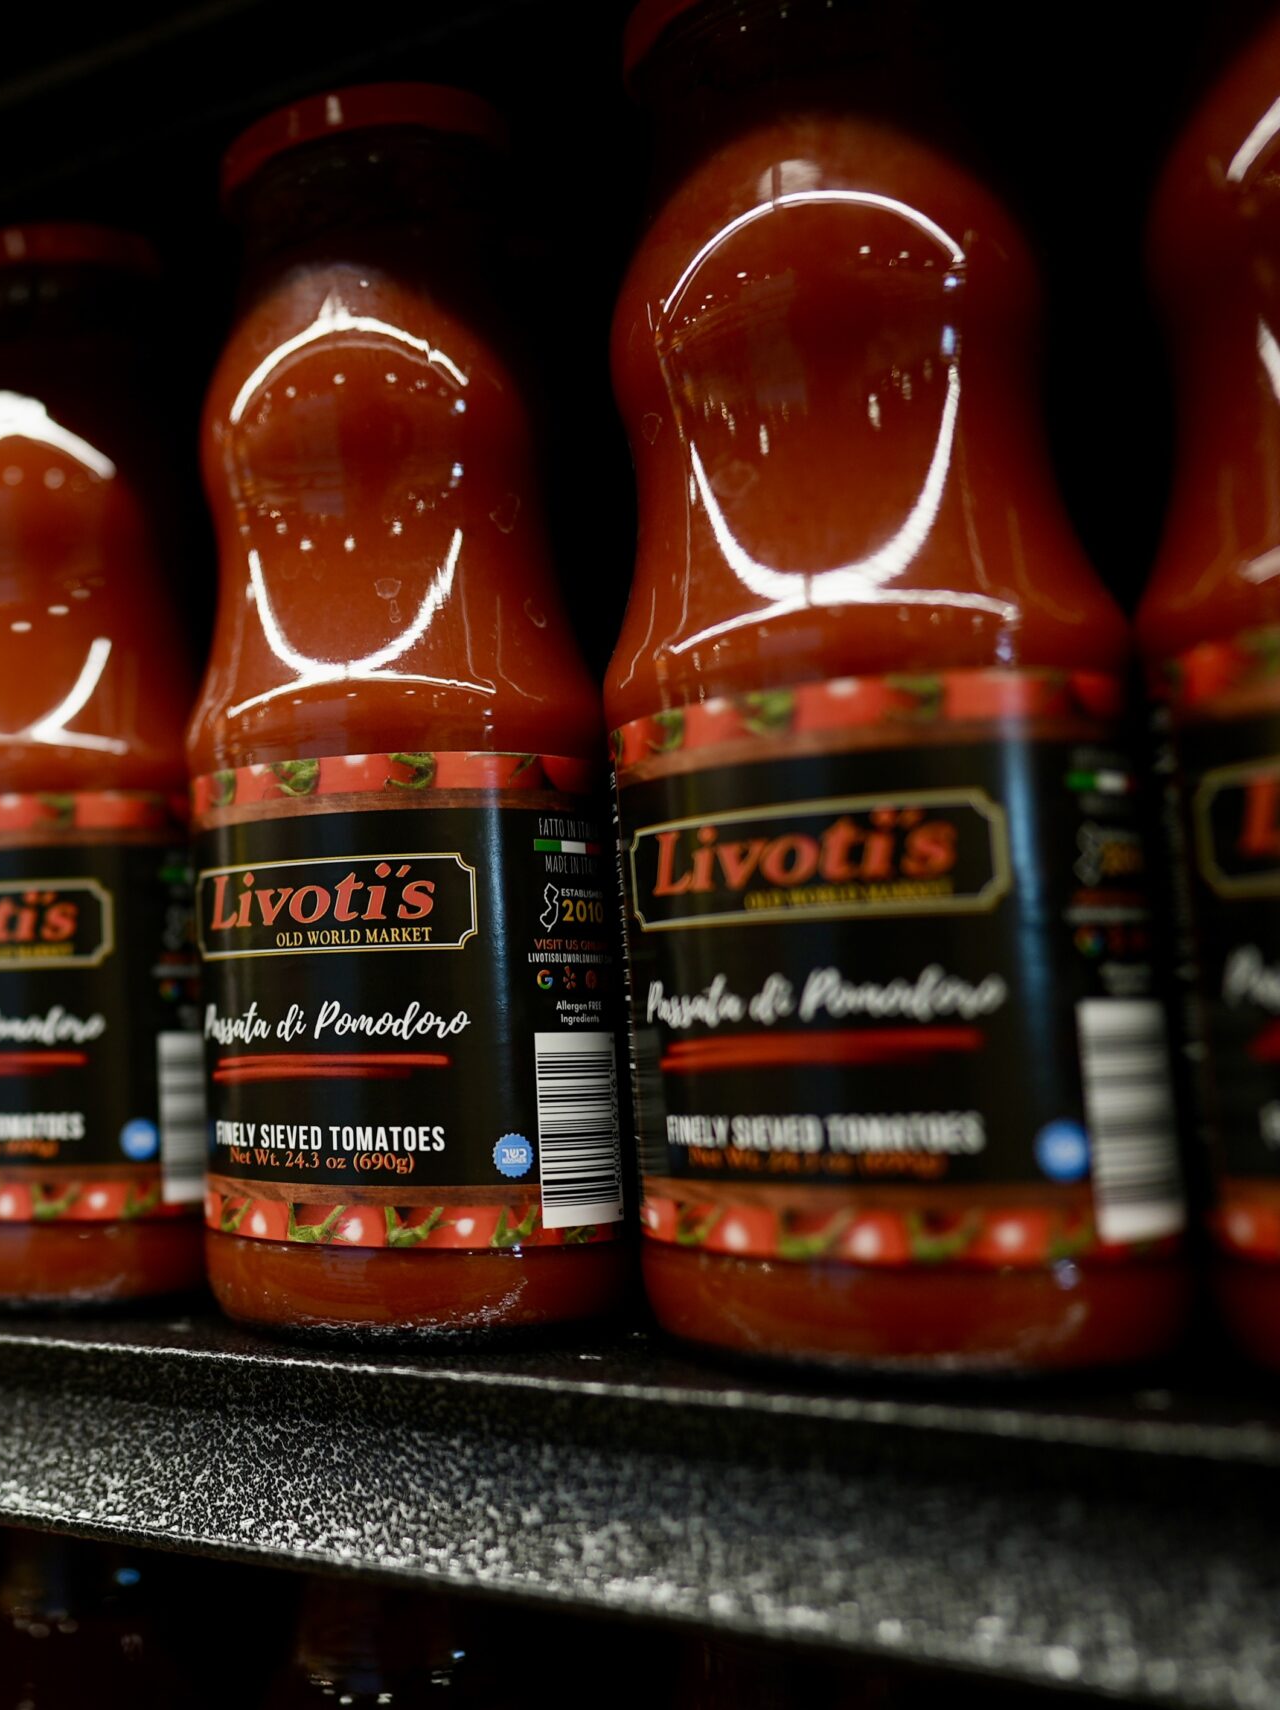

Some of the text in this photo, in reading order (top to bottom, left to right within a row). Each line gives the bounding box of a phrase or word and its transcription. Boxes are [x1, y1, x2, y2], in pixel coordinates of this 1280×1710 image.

[538, 817, 565, 838] FATTO
[567, 819, 576, 838] IN
[653, 803, 958, 898] Livoti's
[545, 854, 568, 874] MADE
[570, 855, 579, 875] IN
[211, 862, 435, 932] Livoti's
[561, 899, 603, 922] 2010
[276, 926, 433, 947] OLD WORLD MARKET
[533, 938, 562, 950] VISIT
[565, 939, 579, 950] US
[556, 1000, 602, 1013] Allergen FREE
[204, 1001, 271, 1045] Passata
[276, 1003, 308, 1043] di
[313, 1000, 472, 1041] Pomodoro
[560, 1013, 600, 1026] Ingredients
[216, 1120, 446, 1152] FINELY SIEVED TOMATOES
[230, 1147, 415, 1175] Net Wt. 24.3 oz (690g)
